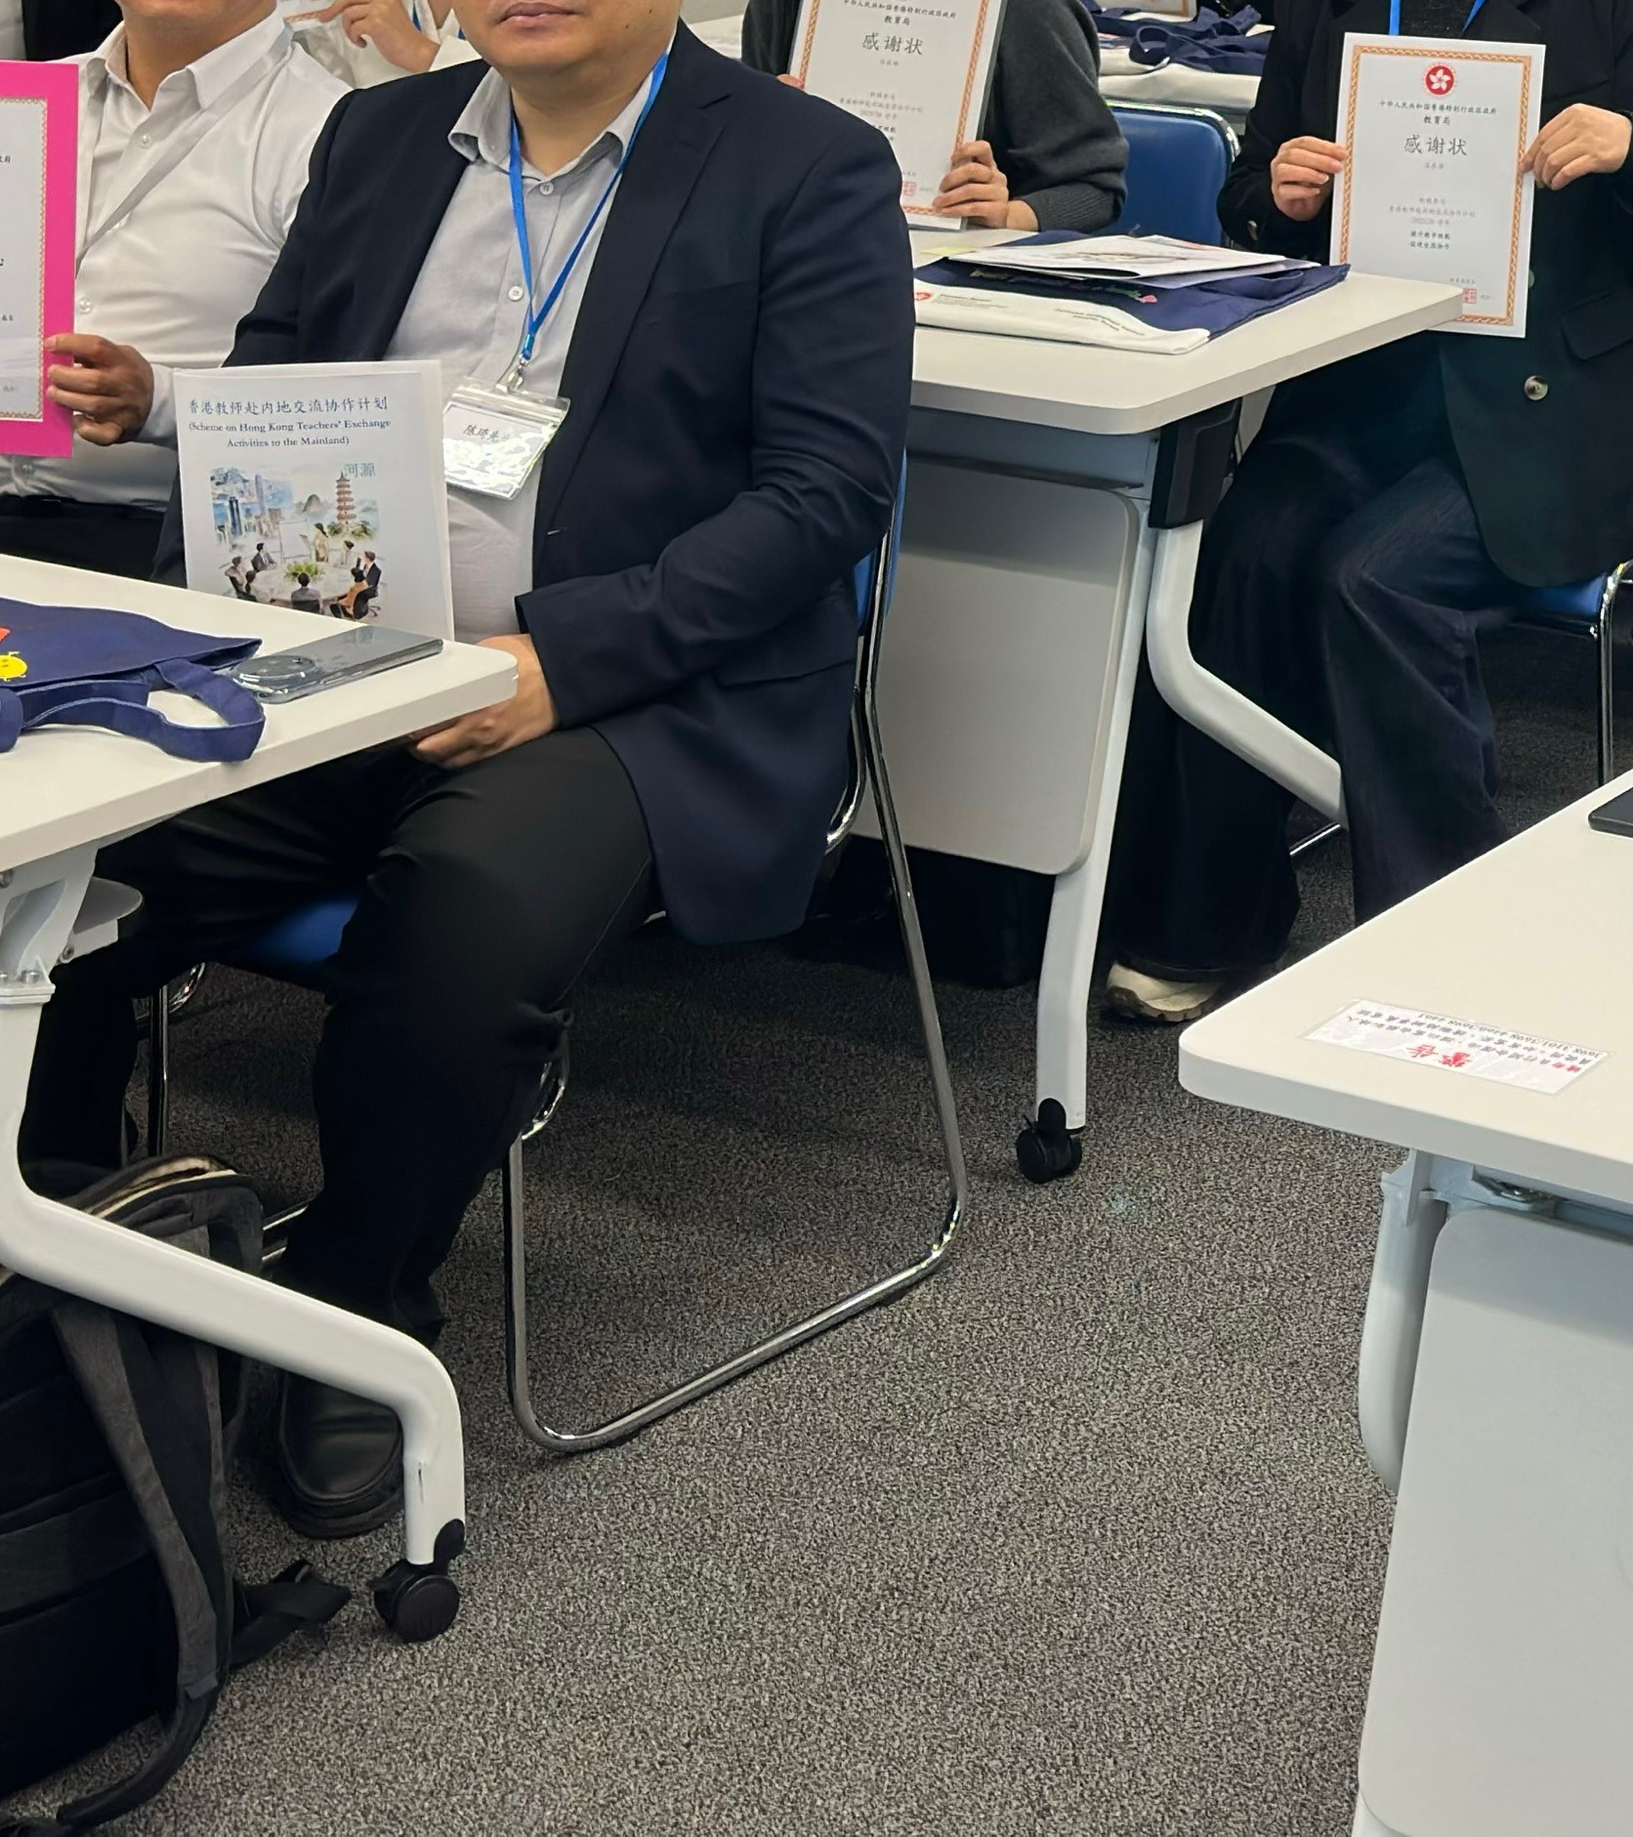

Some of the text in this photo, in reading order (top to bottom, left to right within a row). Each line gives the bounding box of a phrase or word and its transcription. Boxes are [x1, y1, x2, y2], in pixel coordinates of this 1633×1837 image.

[862, 31, 923, 55] 感谢状
[1423, 115, 1451, 126] 教育局
[1404, 134, 1468, 156] 感谢状
[189, 396, 388, 415] 香港教师赴内地交流协作计划
[189, 422, 224, 433] (Scheme
[225, 423, 237, 432] on
[239, 422, 266, 433] Hong
[268, 422, 294, 433] Kong
[344, 418, 391, 429] Exchange
[227, 435, 350, 448] Activities to the Mainland)
[343, 463, 376, 478] 河源
[1406, 1042, 1472, 1069] 警告
